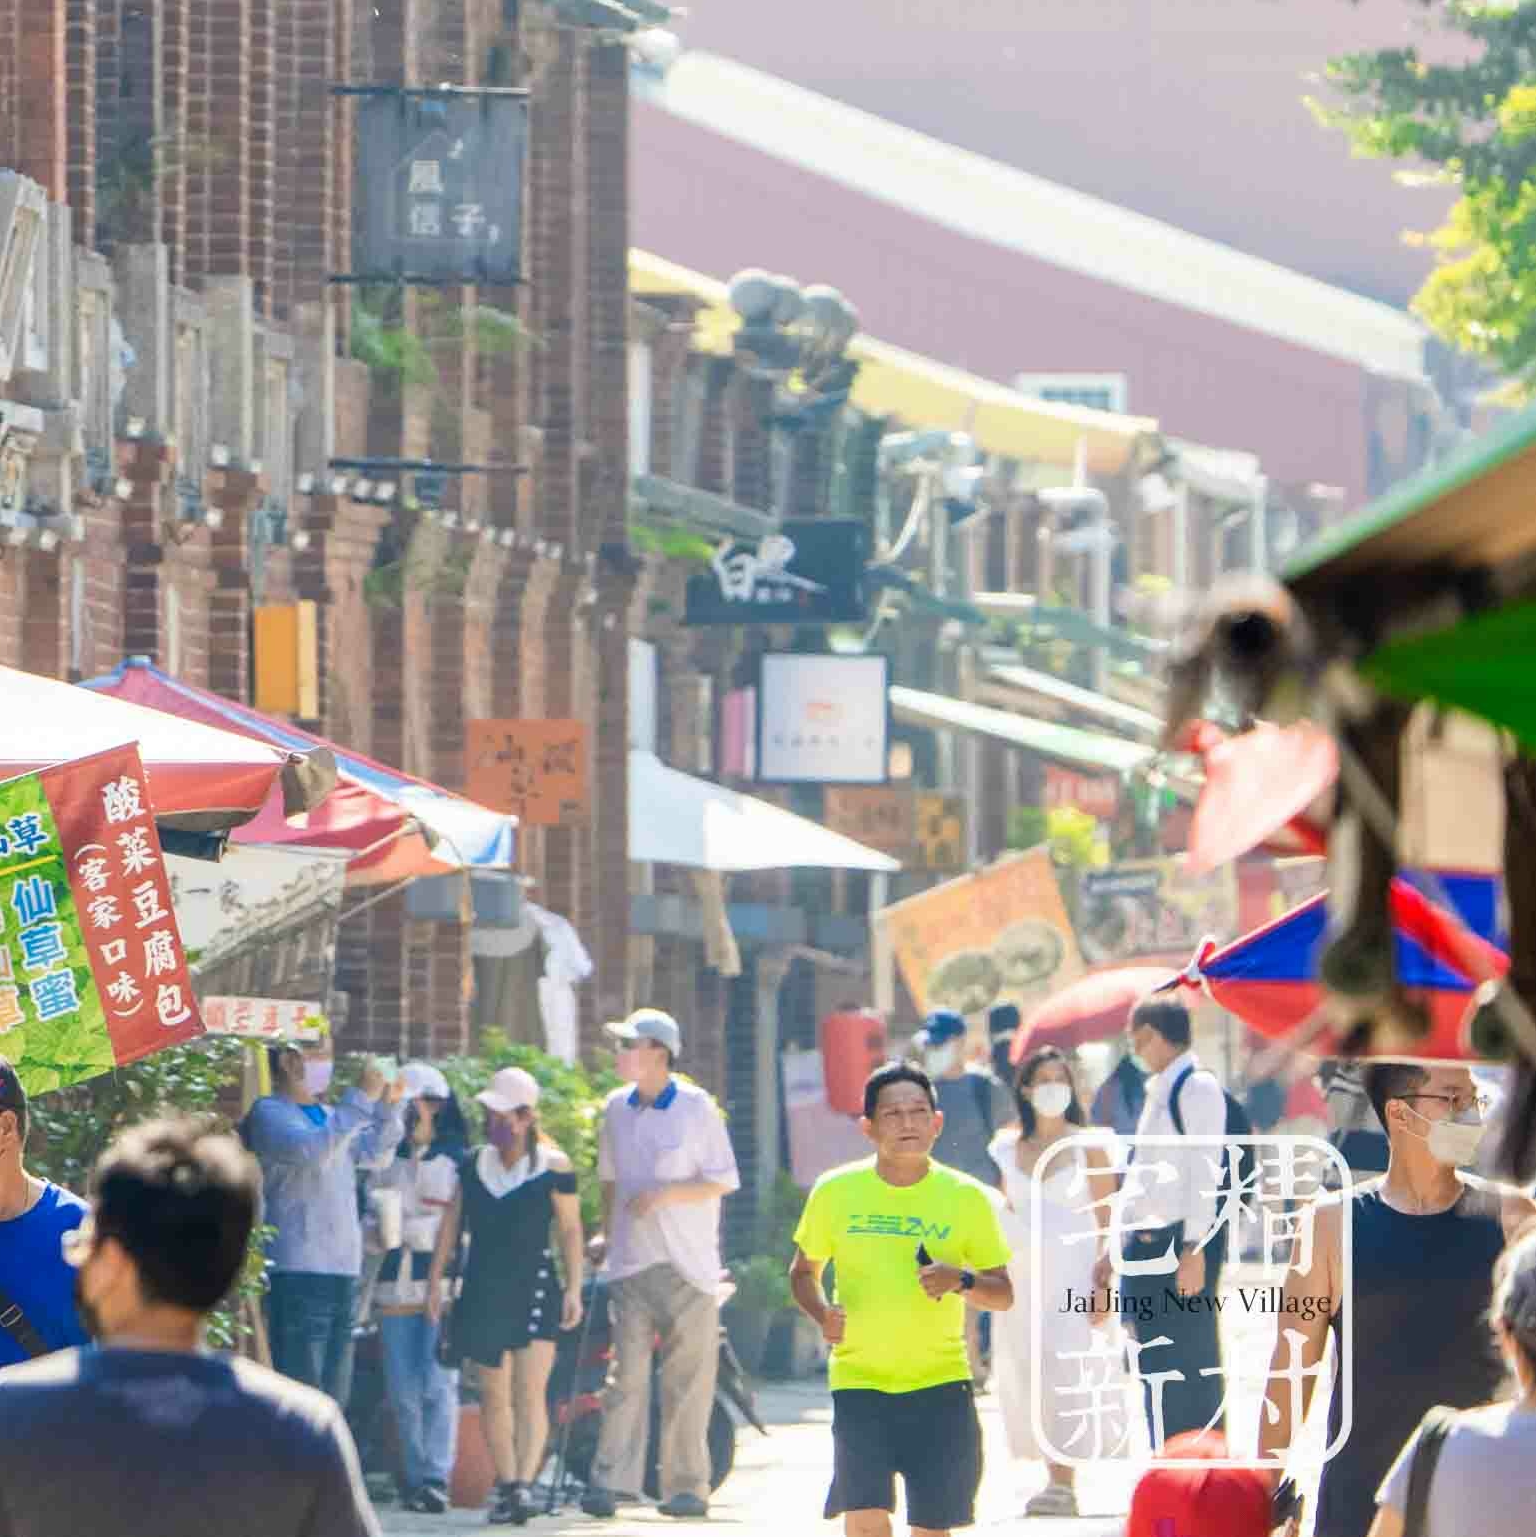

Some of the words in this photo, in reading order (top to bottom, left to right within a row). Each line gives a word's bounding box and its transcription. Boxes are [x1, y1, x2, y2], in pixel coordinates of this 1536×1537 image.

[12, 876, 80, 1023] 仙草蜜
[101, 775, 193, 1026] 酸菜豆腐包
